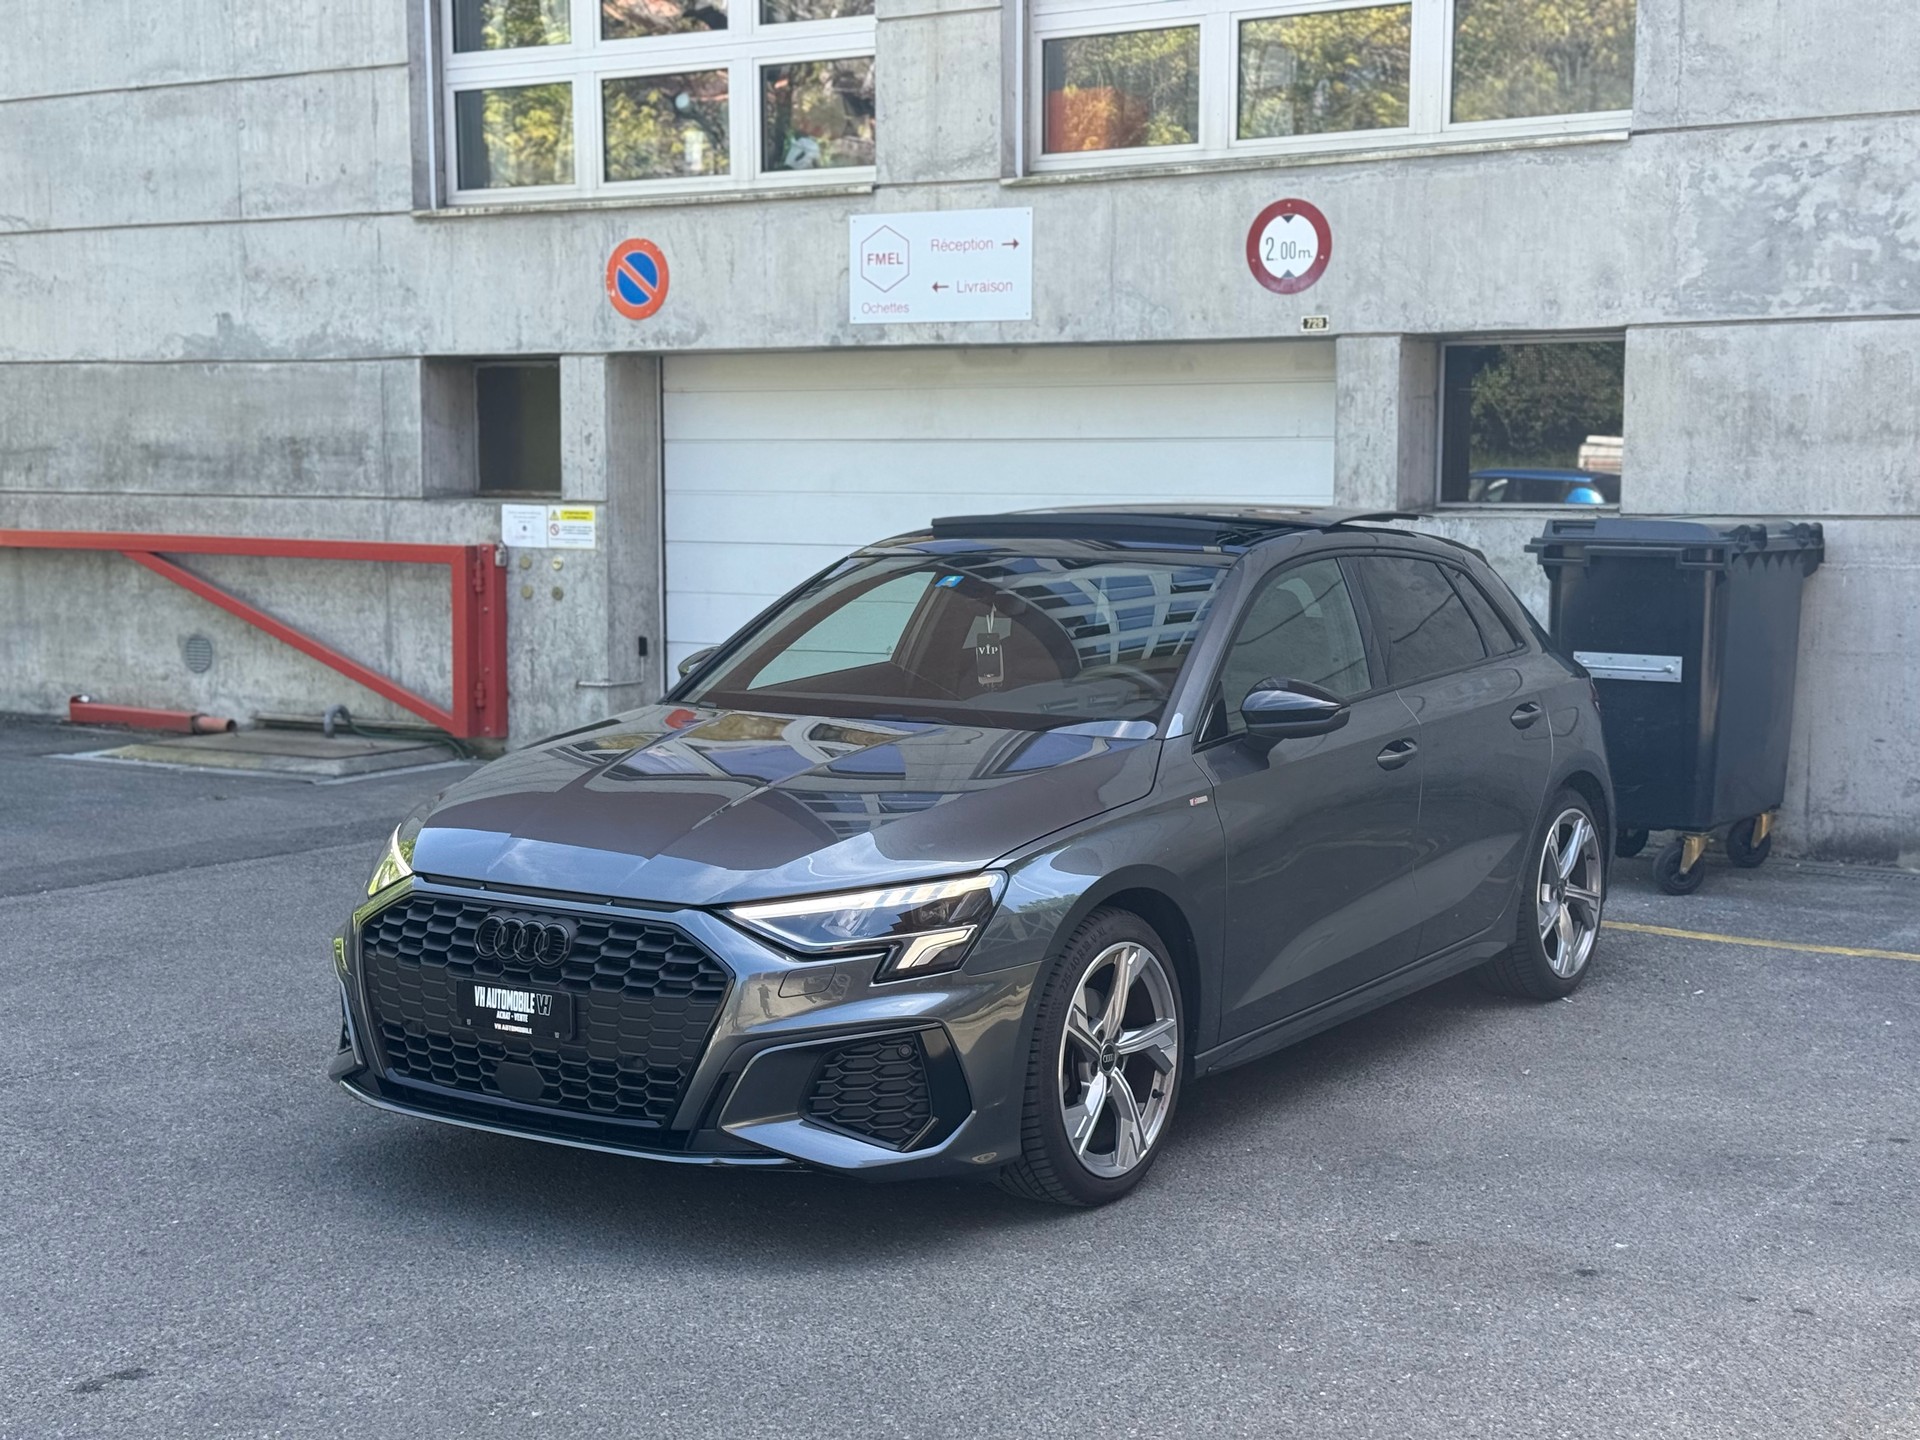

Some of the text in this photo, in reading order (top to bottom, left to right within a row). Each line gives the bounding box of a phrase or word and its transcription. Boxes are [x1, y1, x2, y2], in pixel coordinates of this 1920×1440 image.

[931, 238, 993, 253] Réception
[867, 252, 904, 266] FMEL
[956, 279, 1014, 294] Livraison
[861, 302, 910, 315] Ochettes
[474, 985, 535, 1014] VH AUTOMOBILE
